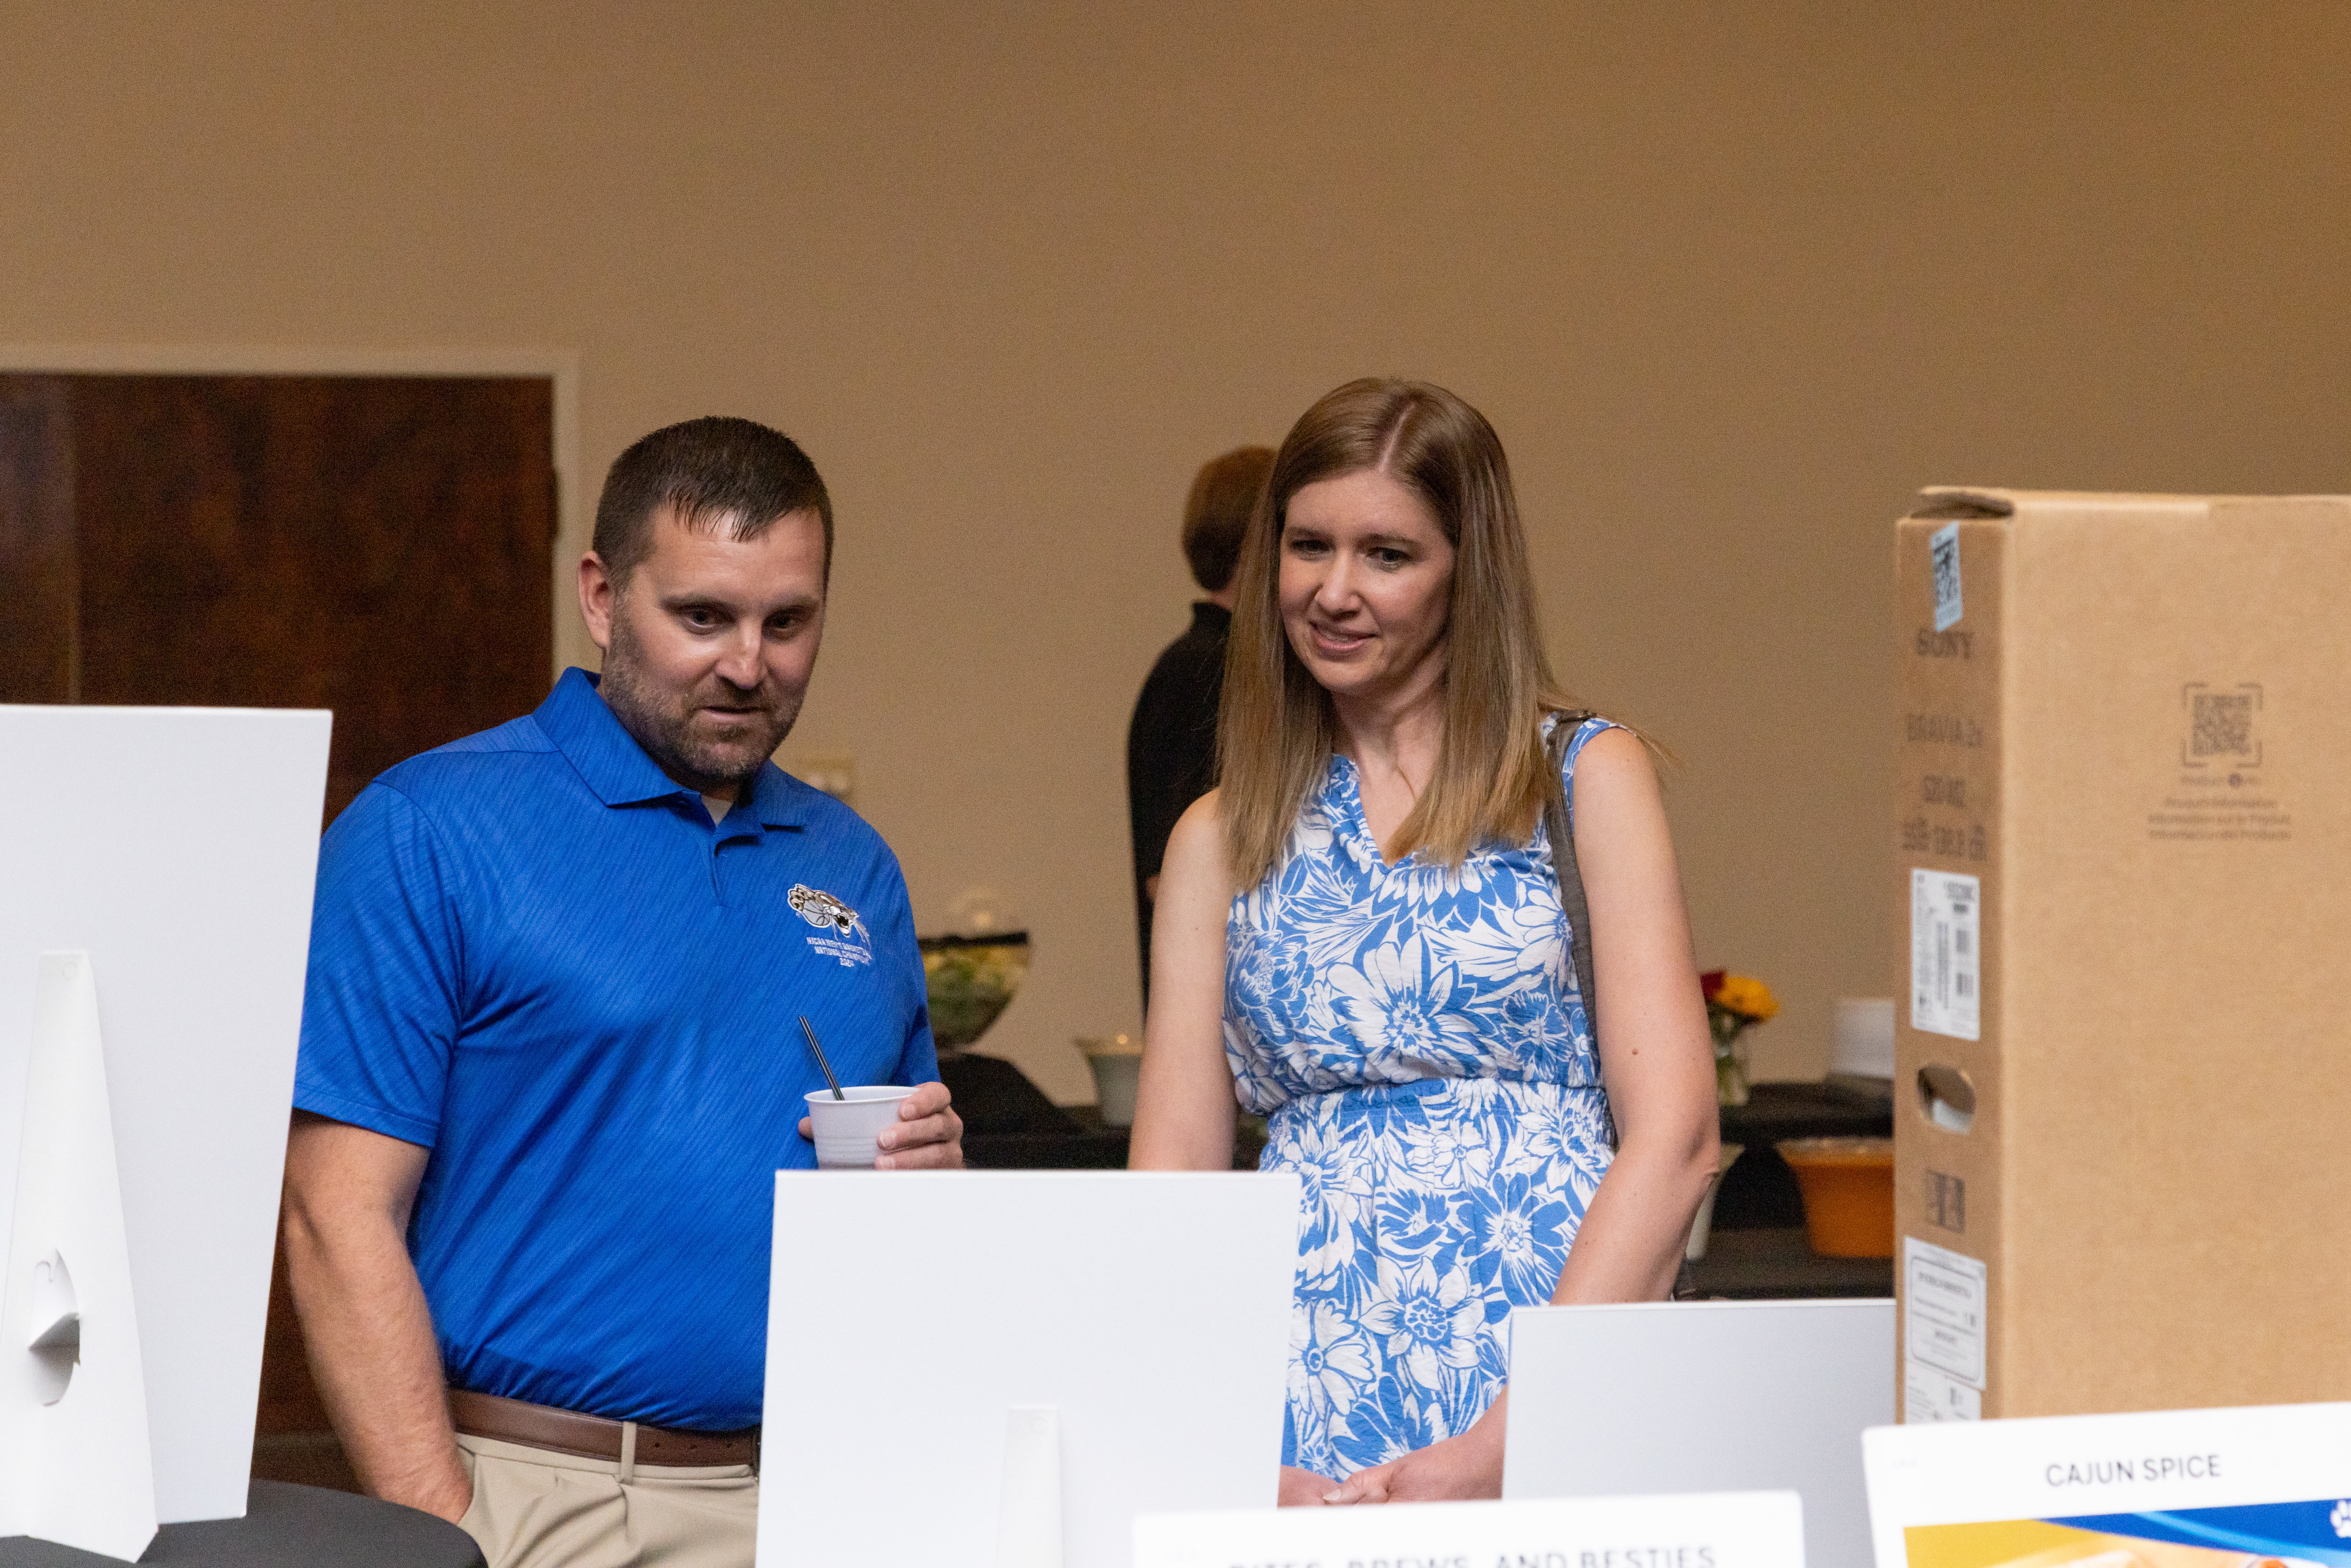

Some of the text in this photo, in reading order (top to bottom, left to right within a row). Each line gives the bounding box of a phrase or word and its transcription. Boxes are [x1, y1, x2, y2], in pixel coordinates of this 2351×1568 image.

[1916, 629, 1974, 659] SONY
[2046, 1454, 2221, 1487] CAJUN SPICE
[1497, 1551, 1567, 1568] AND
[1580, 1545, 1716, 1568] BESTIES
